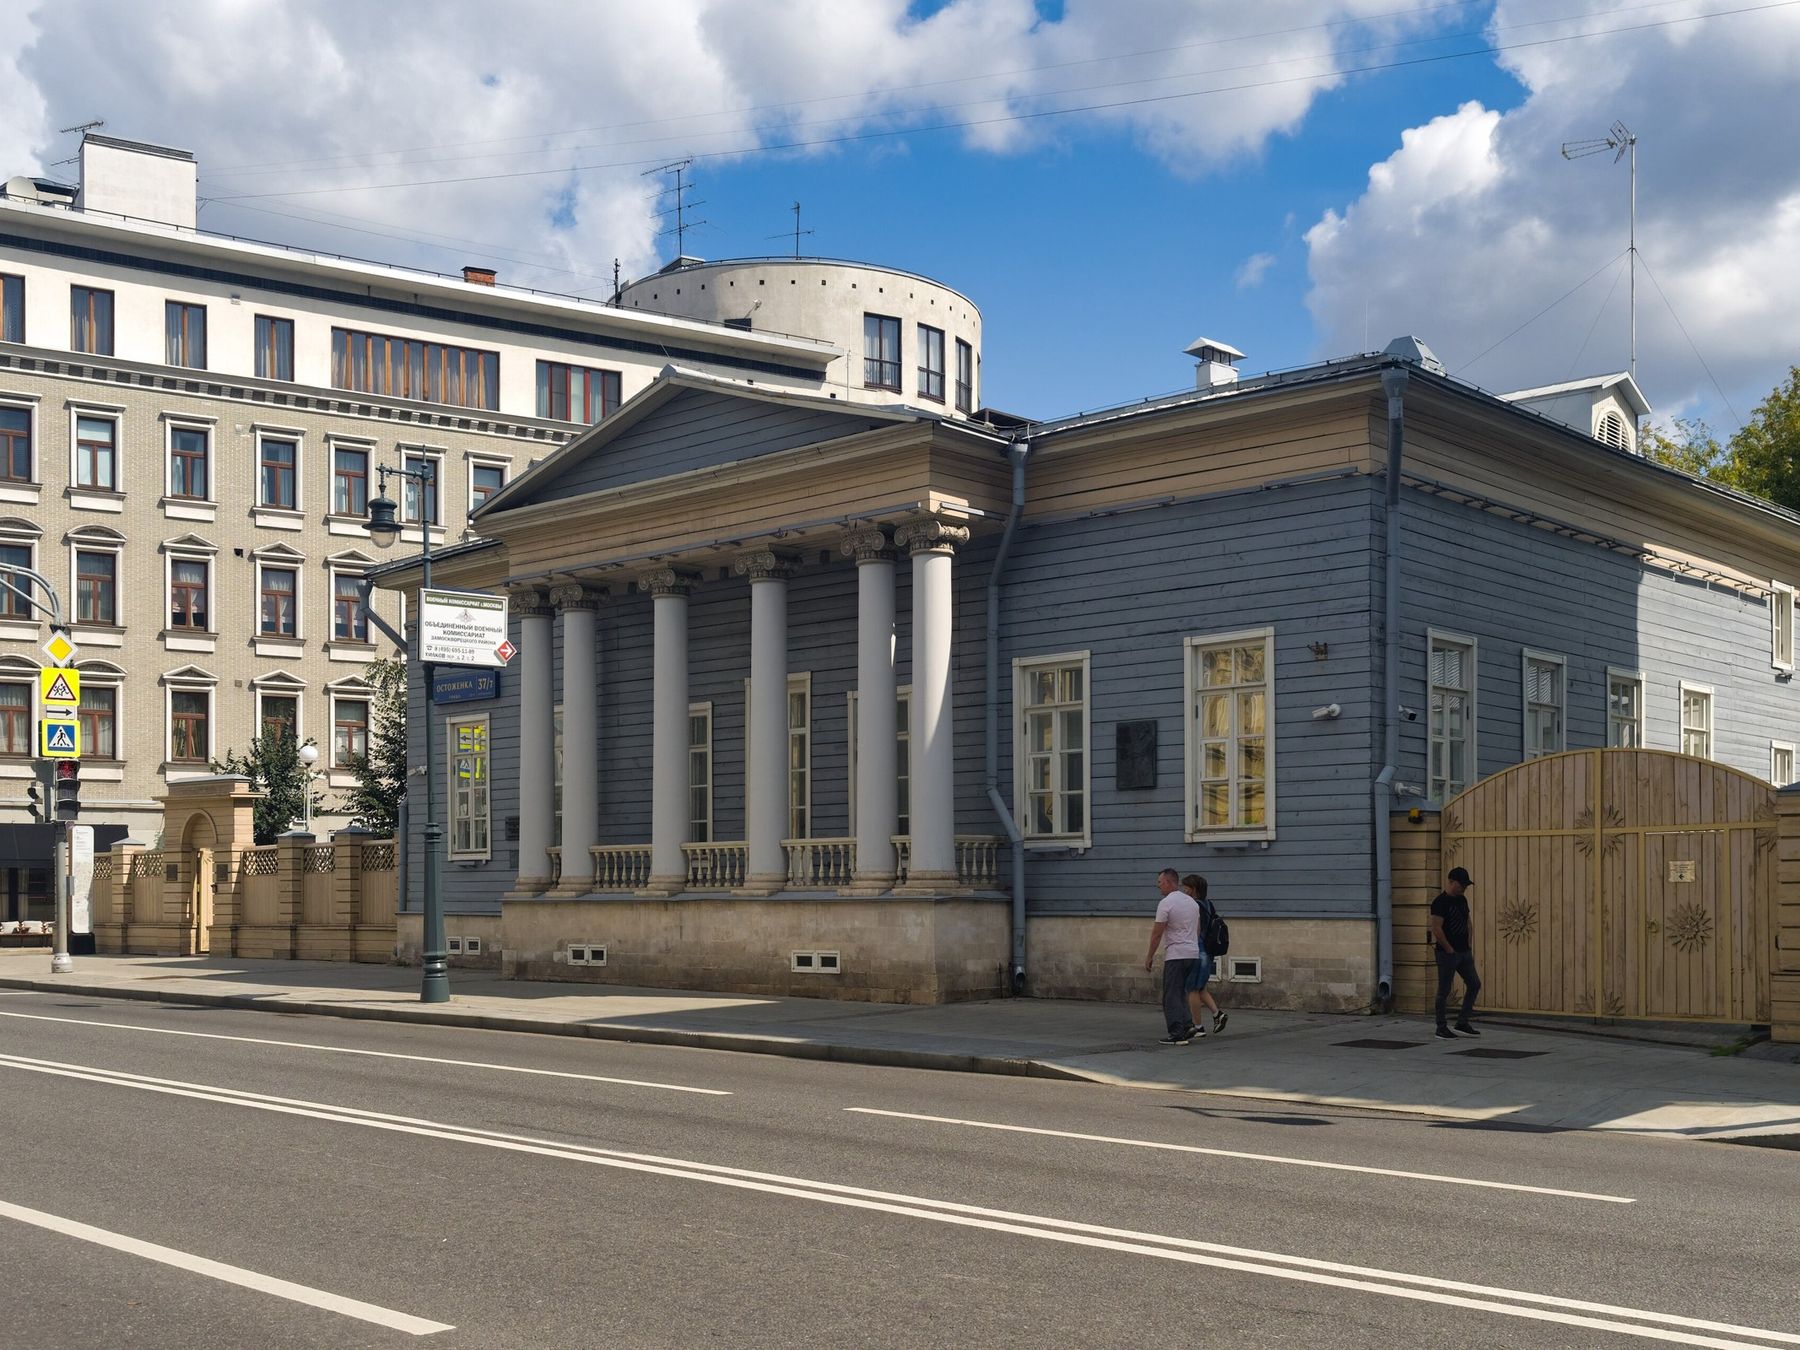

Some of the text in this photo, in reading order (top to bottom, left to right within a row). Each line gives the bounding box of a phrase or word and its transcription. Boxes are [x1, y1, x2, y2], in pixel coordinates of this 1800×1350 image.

[448, 599, 480, 607] КОМИССАРИАТ
[474, 625, 503, 633] ВОЕННЫЙ
[442, 630, 485, 638] КОМИССАРИАТ
[436, 681, 473, 692] ОСТОЖЕНКА
